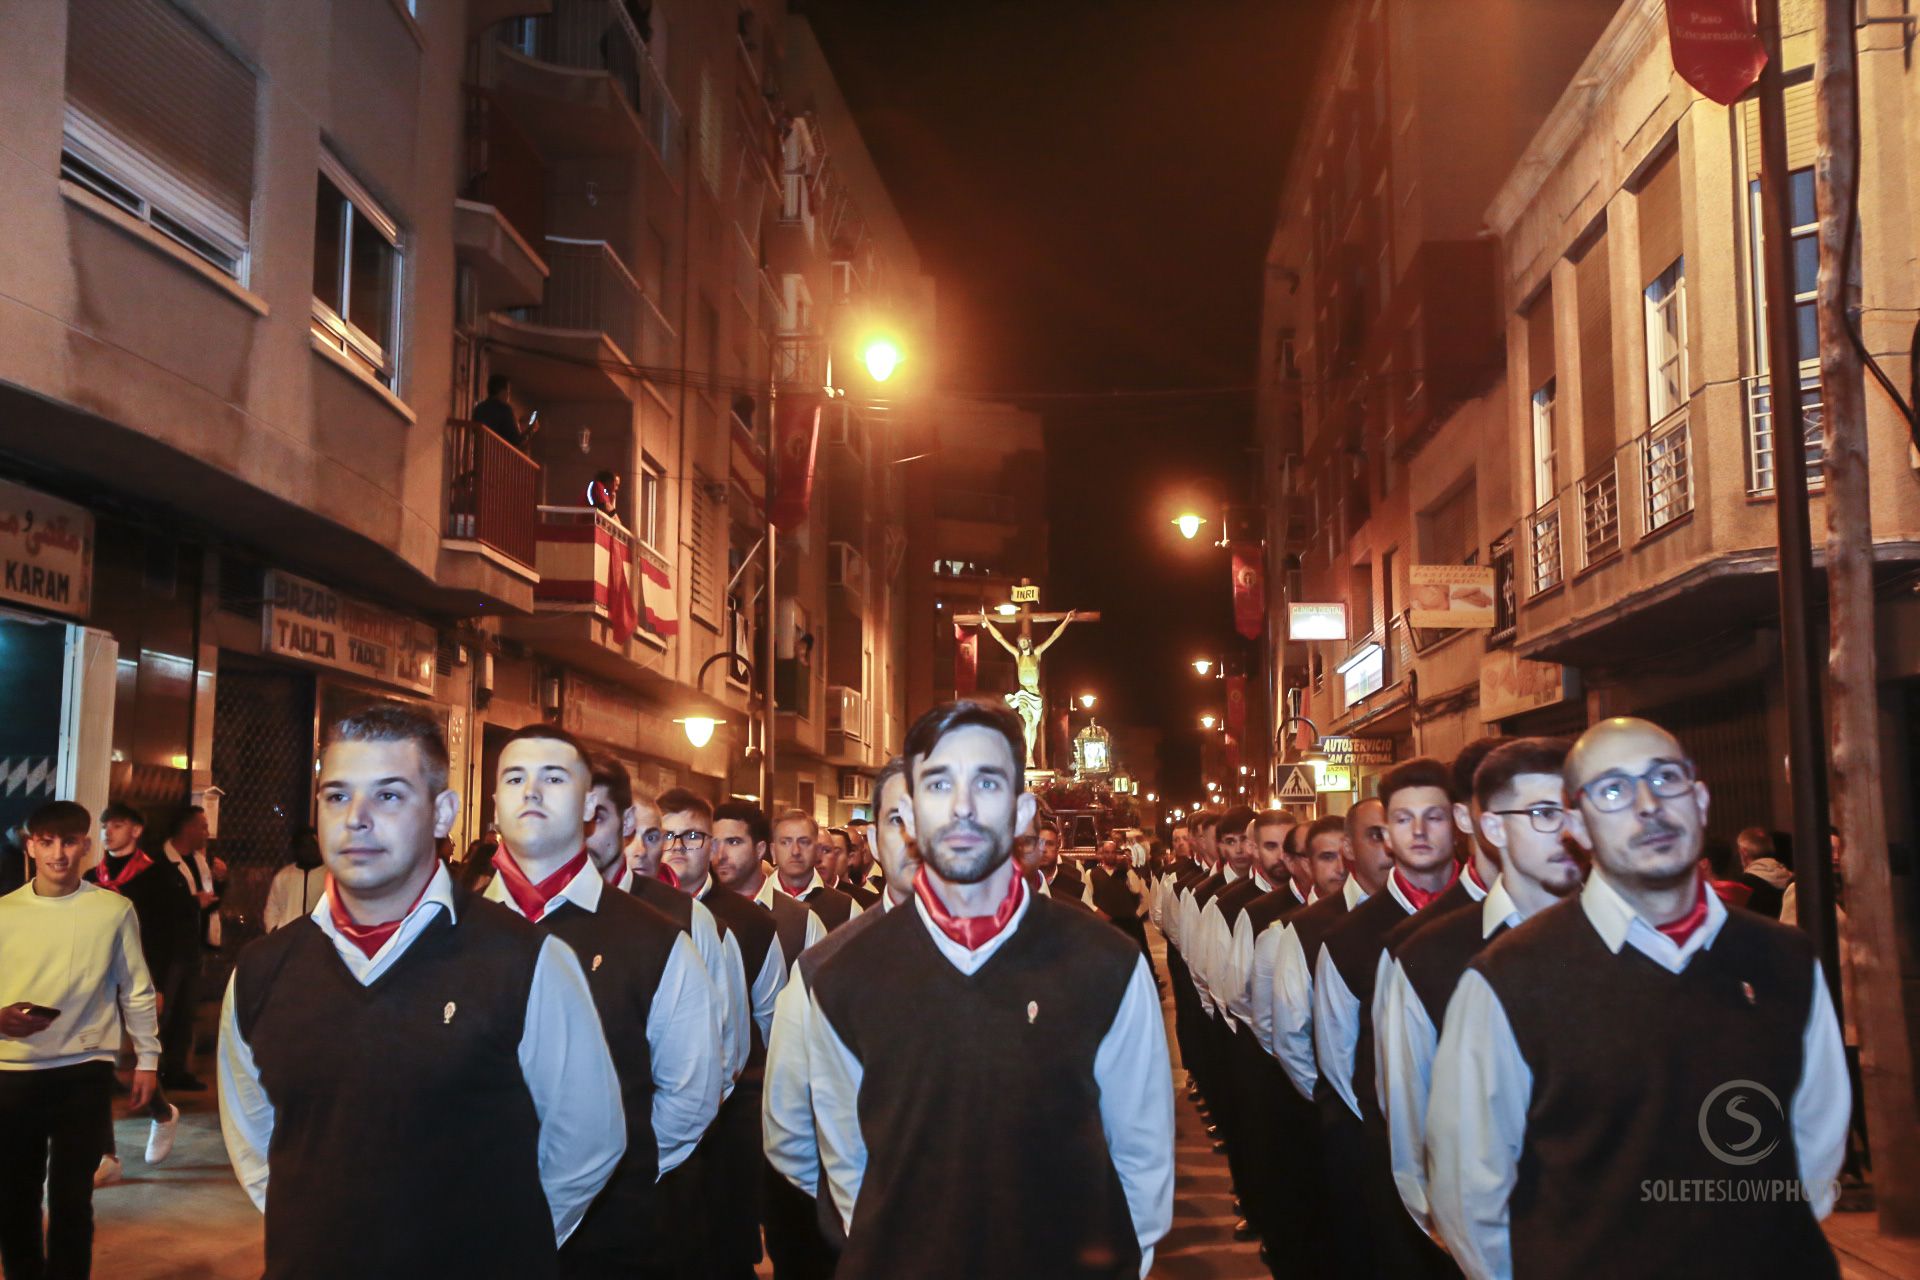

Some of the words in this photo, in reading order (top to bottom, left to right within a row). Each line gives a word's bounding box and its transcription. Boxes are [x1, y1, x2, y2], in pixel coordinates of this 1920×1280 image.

[1690, 12, 1722, 24] Paso
[5, 559, 69, 604] KARAM
[1016, 589, 1035, 599] INRI
[275, 579, 337, 624] BAZAR
[1323, 738, 1392, 752] AUTOSERVICIO
[1344, 753, 1392, 764] CRISTOBAL
